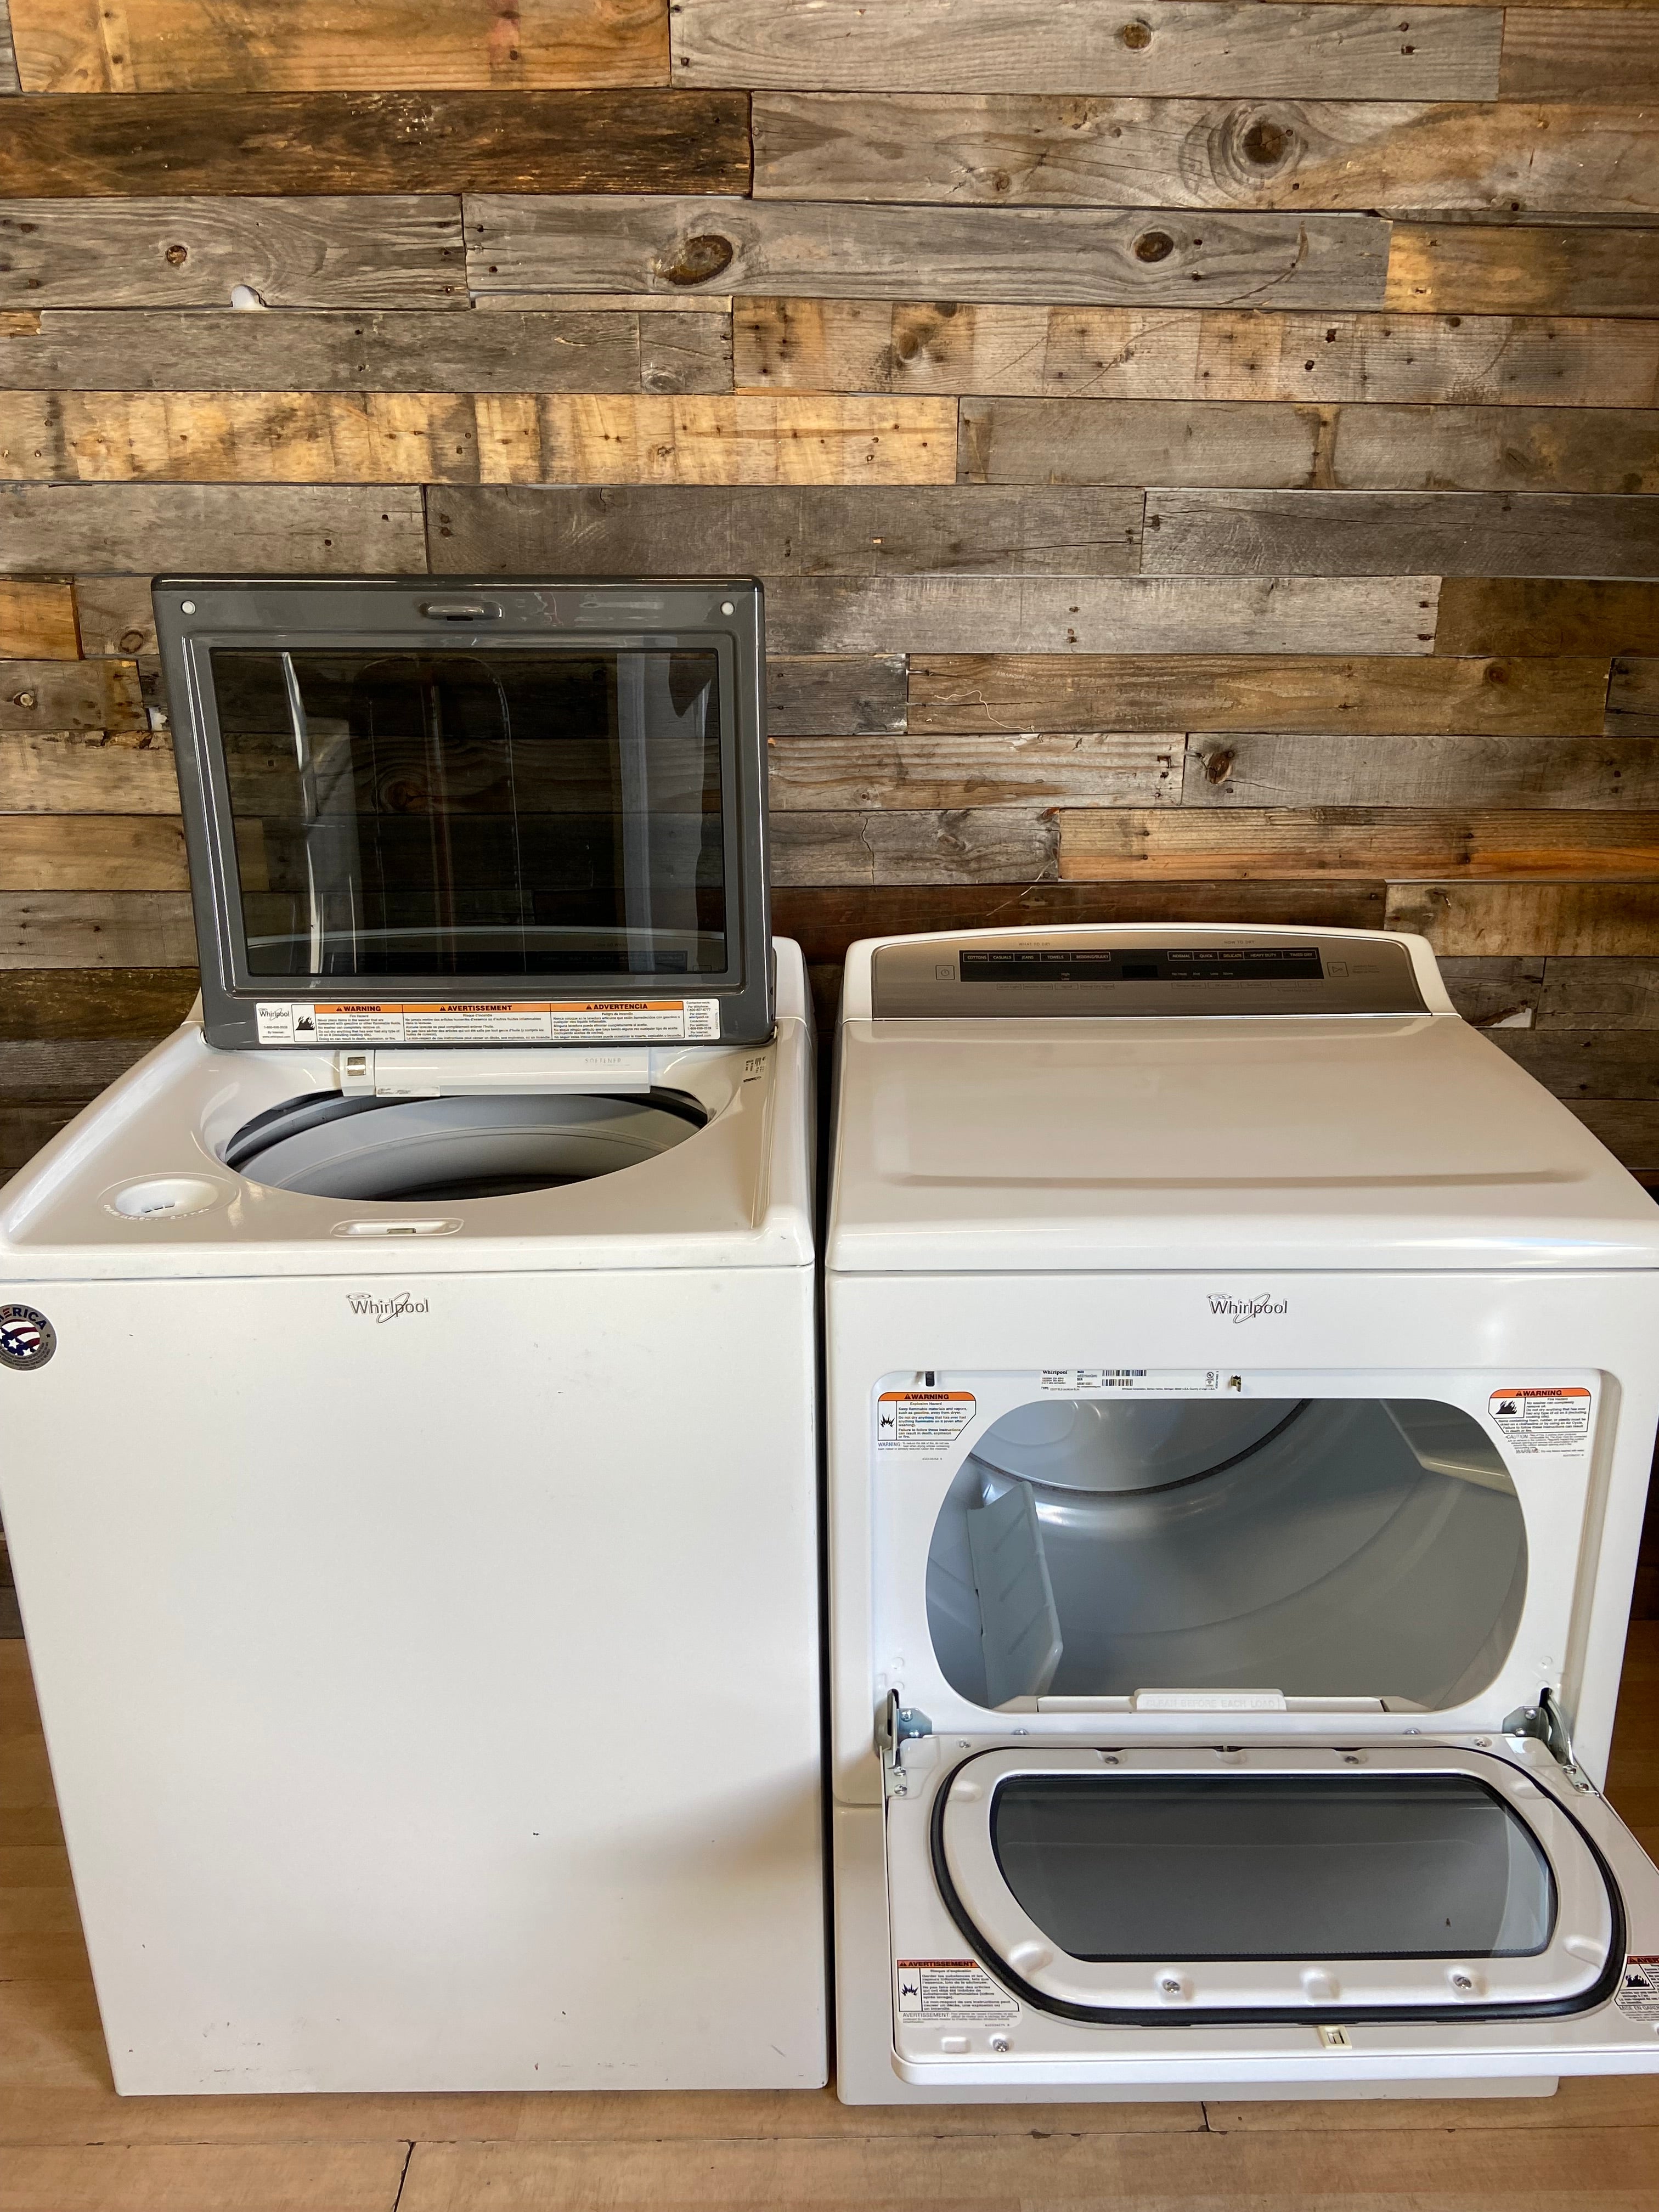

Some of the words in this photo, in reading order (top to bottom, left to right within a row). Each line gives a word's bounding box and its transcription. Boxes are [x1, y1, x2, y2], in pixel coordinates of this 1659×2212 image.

[259, 1009, 290, 1020] Whirlpool
[348, 1295, 430, 1321] Whirlpool
[1209, 1295, 1288, 1321] Whirlpool
[1181, 1700, 1216, 1708] BEFORE
[1221, 1700, 1246, 1708] EACH
[1251, 1700, 1273, 1708] LOAD
